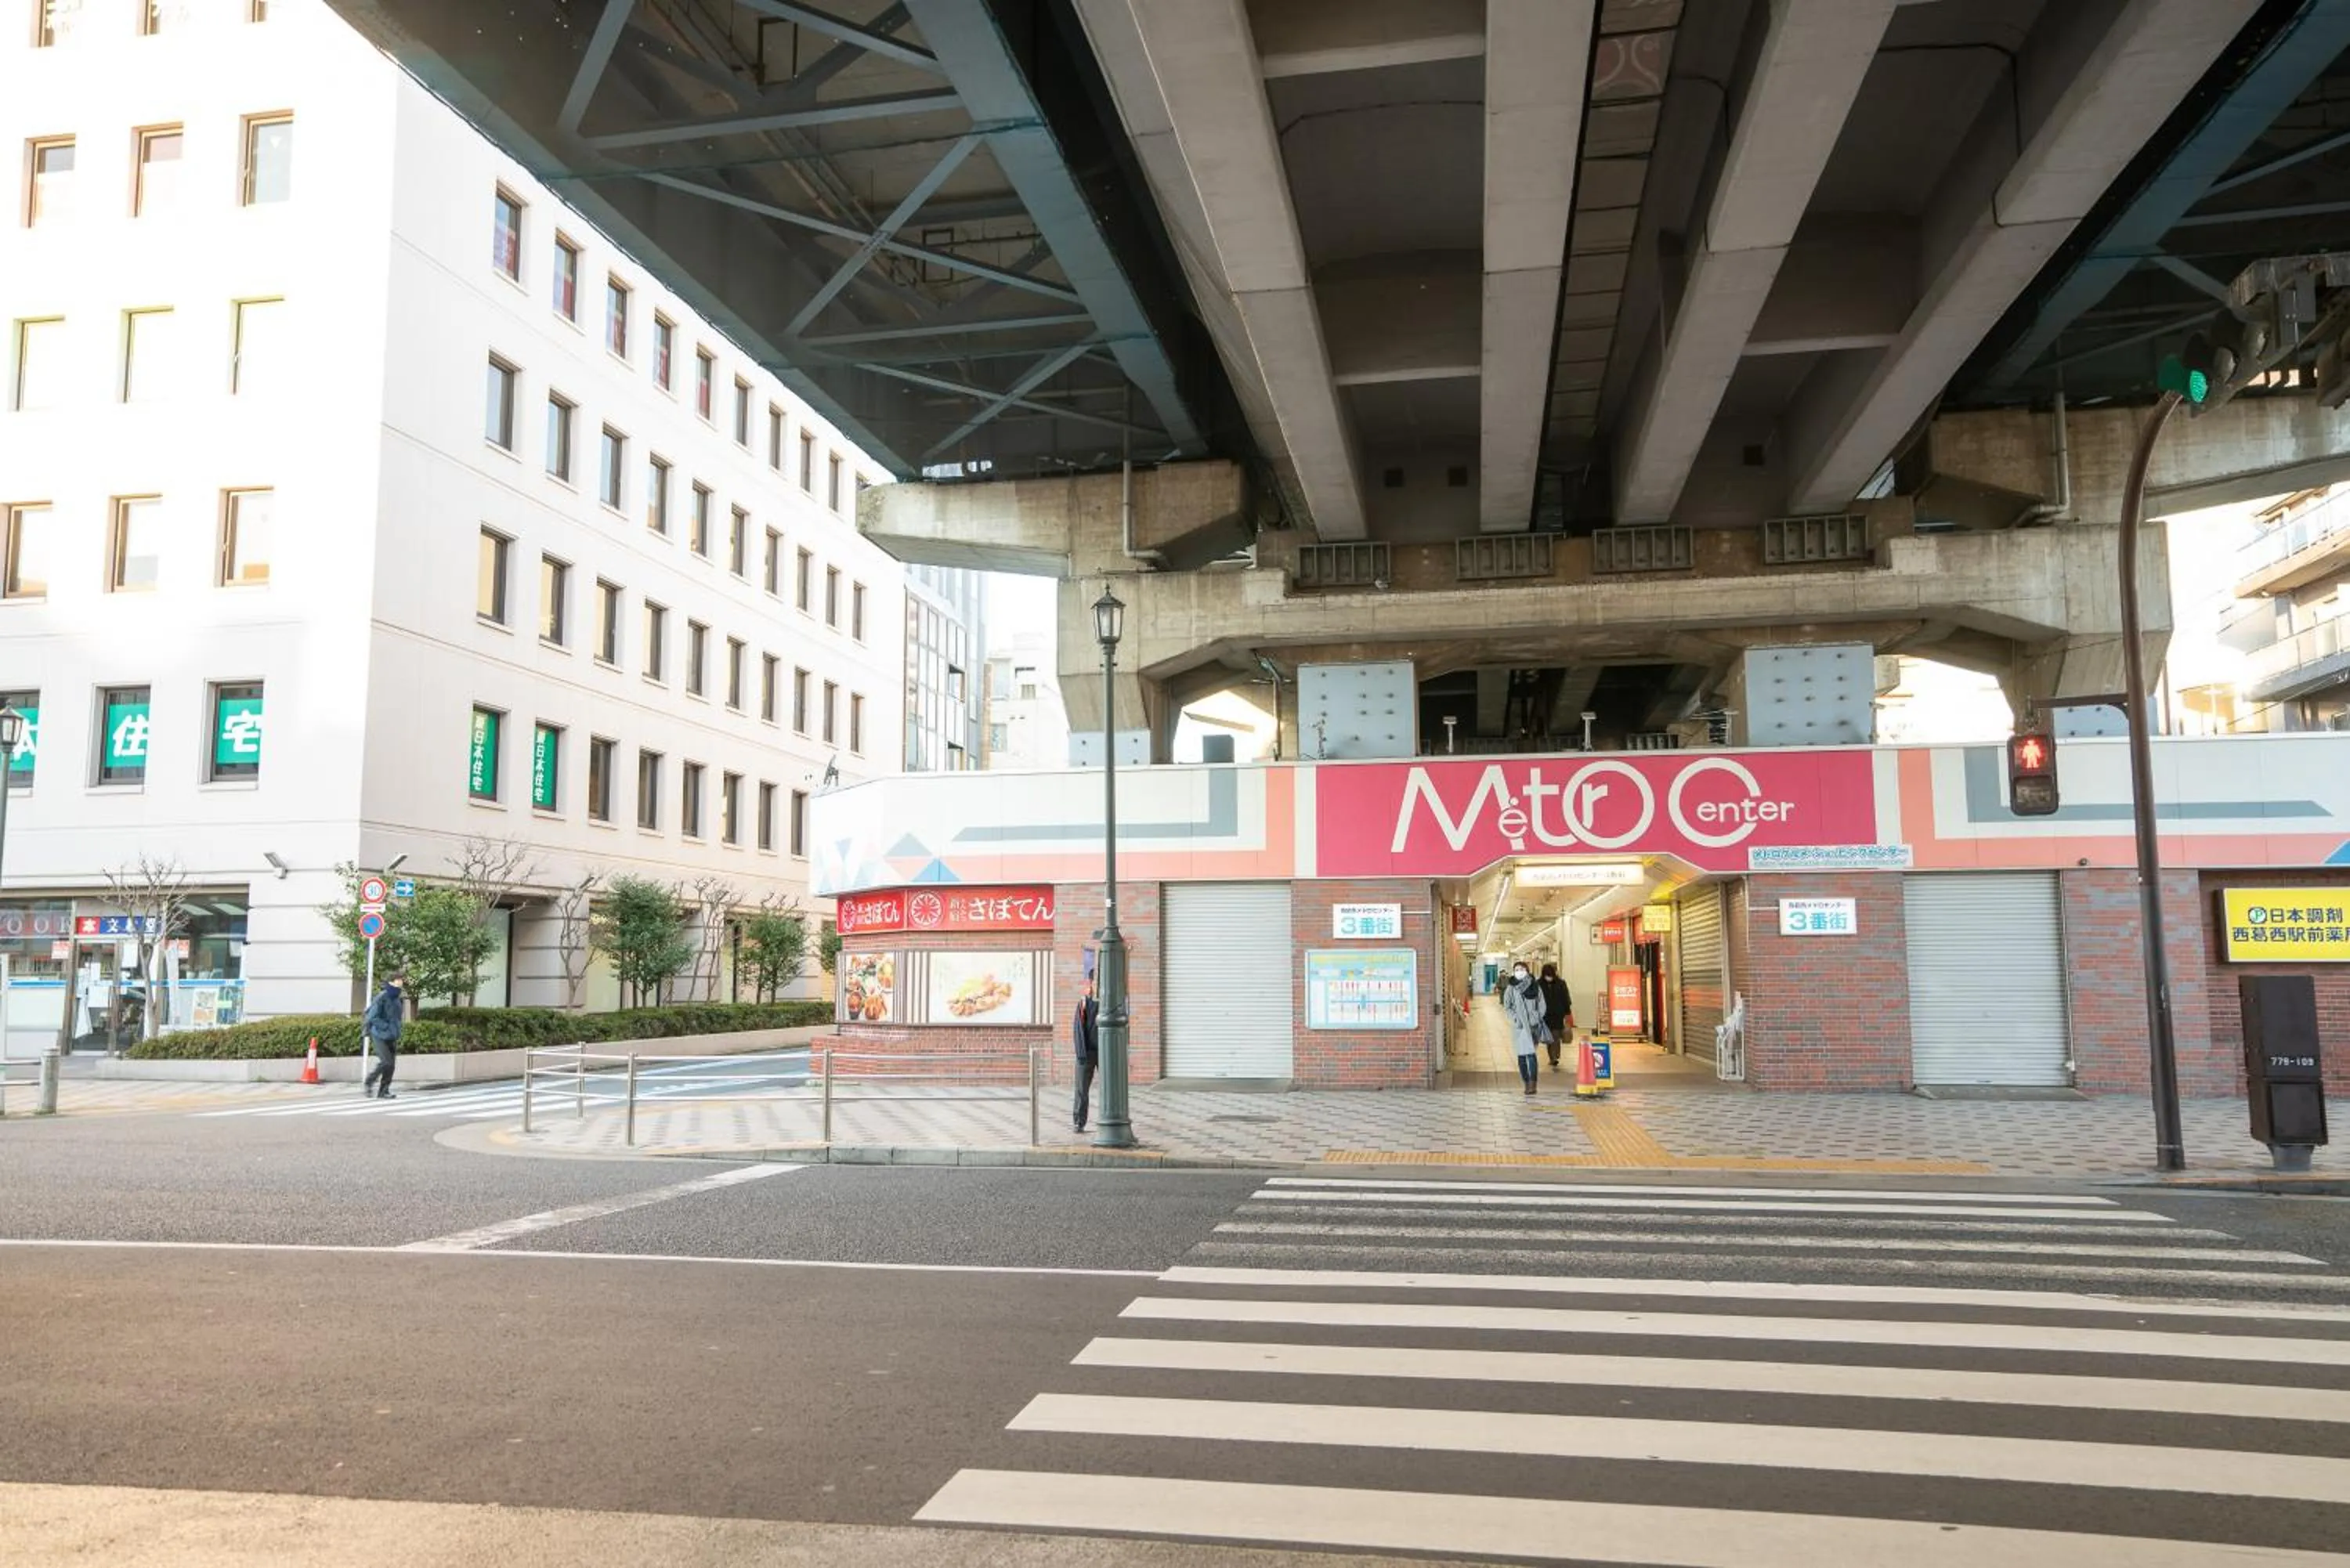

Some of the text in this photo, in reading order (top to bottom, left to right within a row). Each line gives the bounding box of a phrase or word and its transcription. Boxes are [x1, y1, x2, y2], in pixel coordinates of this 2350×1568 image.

[112, 714, 148, 757] 住
[222, 710, 262, 753] 宅
[1668, 757, 1795, 848] Center
[968, 896, 1054, 921] さぼてん
[2269, 908, 2343, 923] 日本調剤
[1340, 916, 1395, 934] 3番街
[1788, 911, 1848, 931] 3番街
